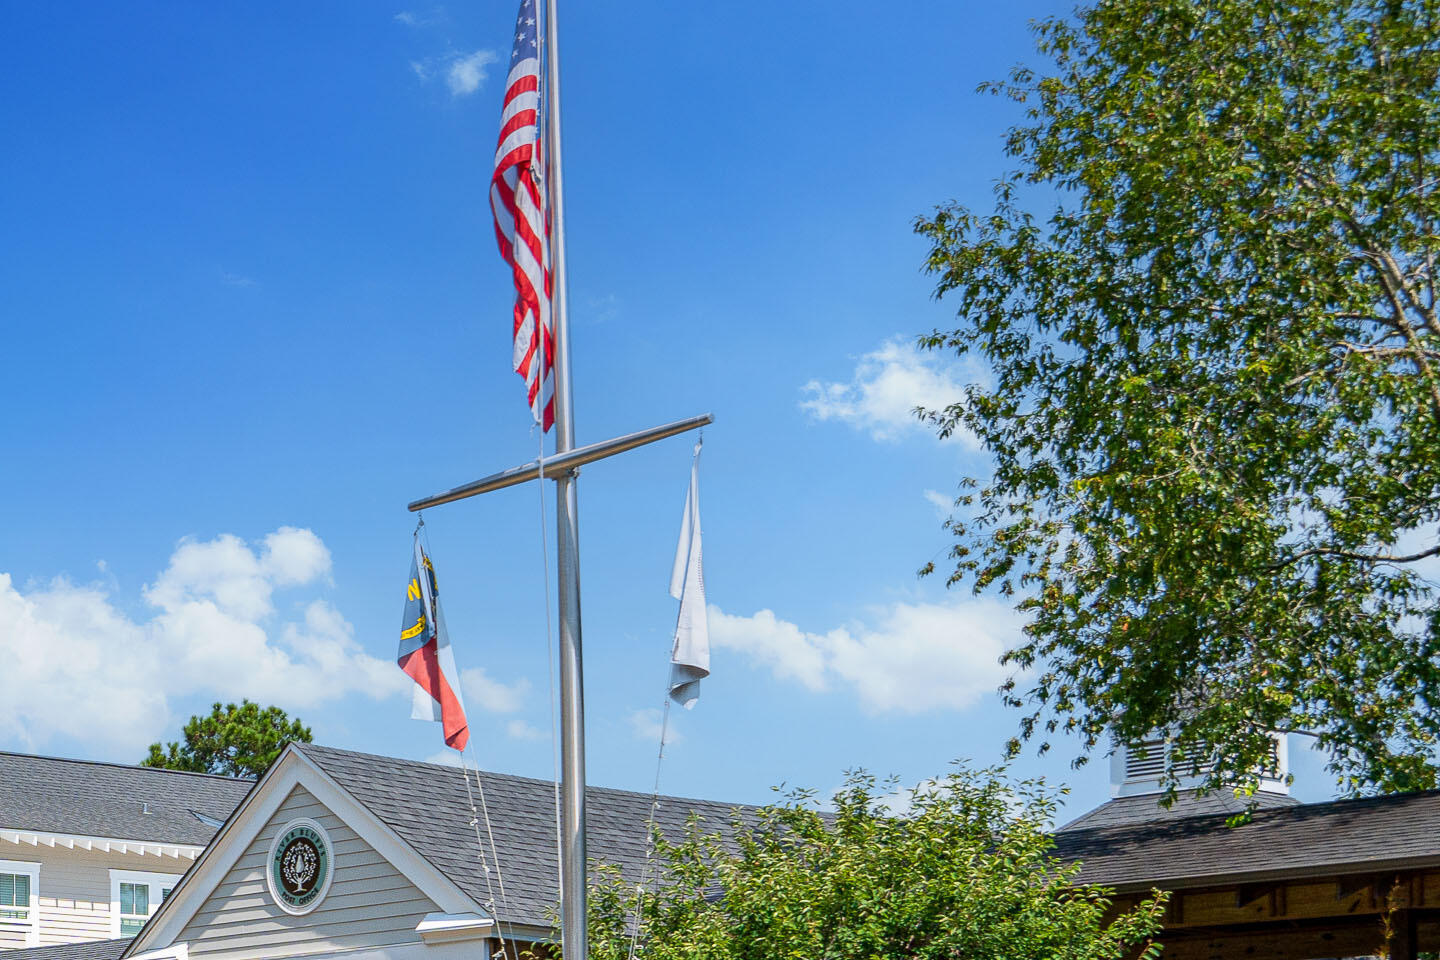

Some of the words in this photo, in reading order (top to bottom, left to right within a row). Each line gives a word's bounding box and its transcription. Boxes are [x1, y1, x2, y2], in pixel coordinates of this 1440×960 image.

[408, 578, 422, 601] N
[282, 891, 296, 905] POST
[299, 888, 319, 905] OFFICE
